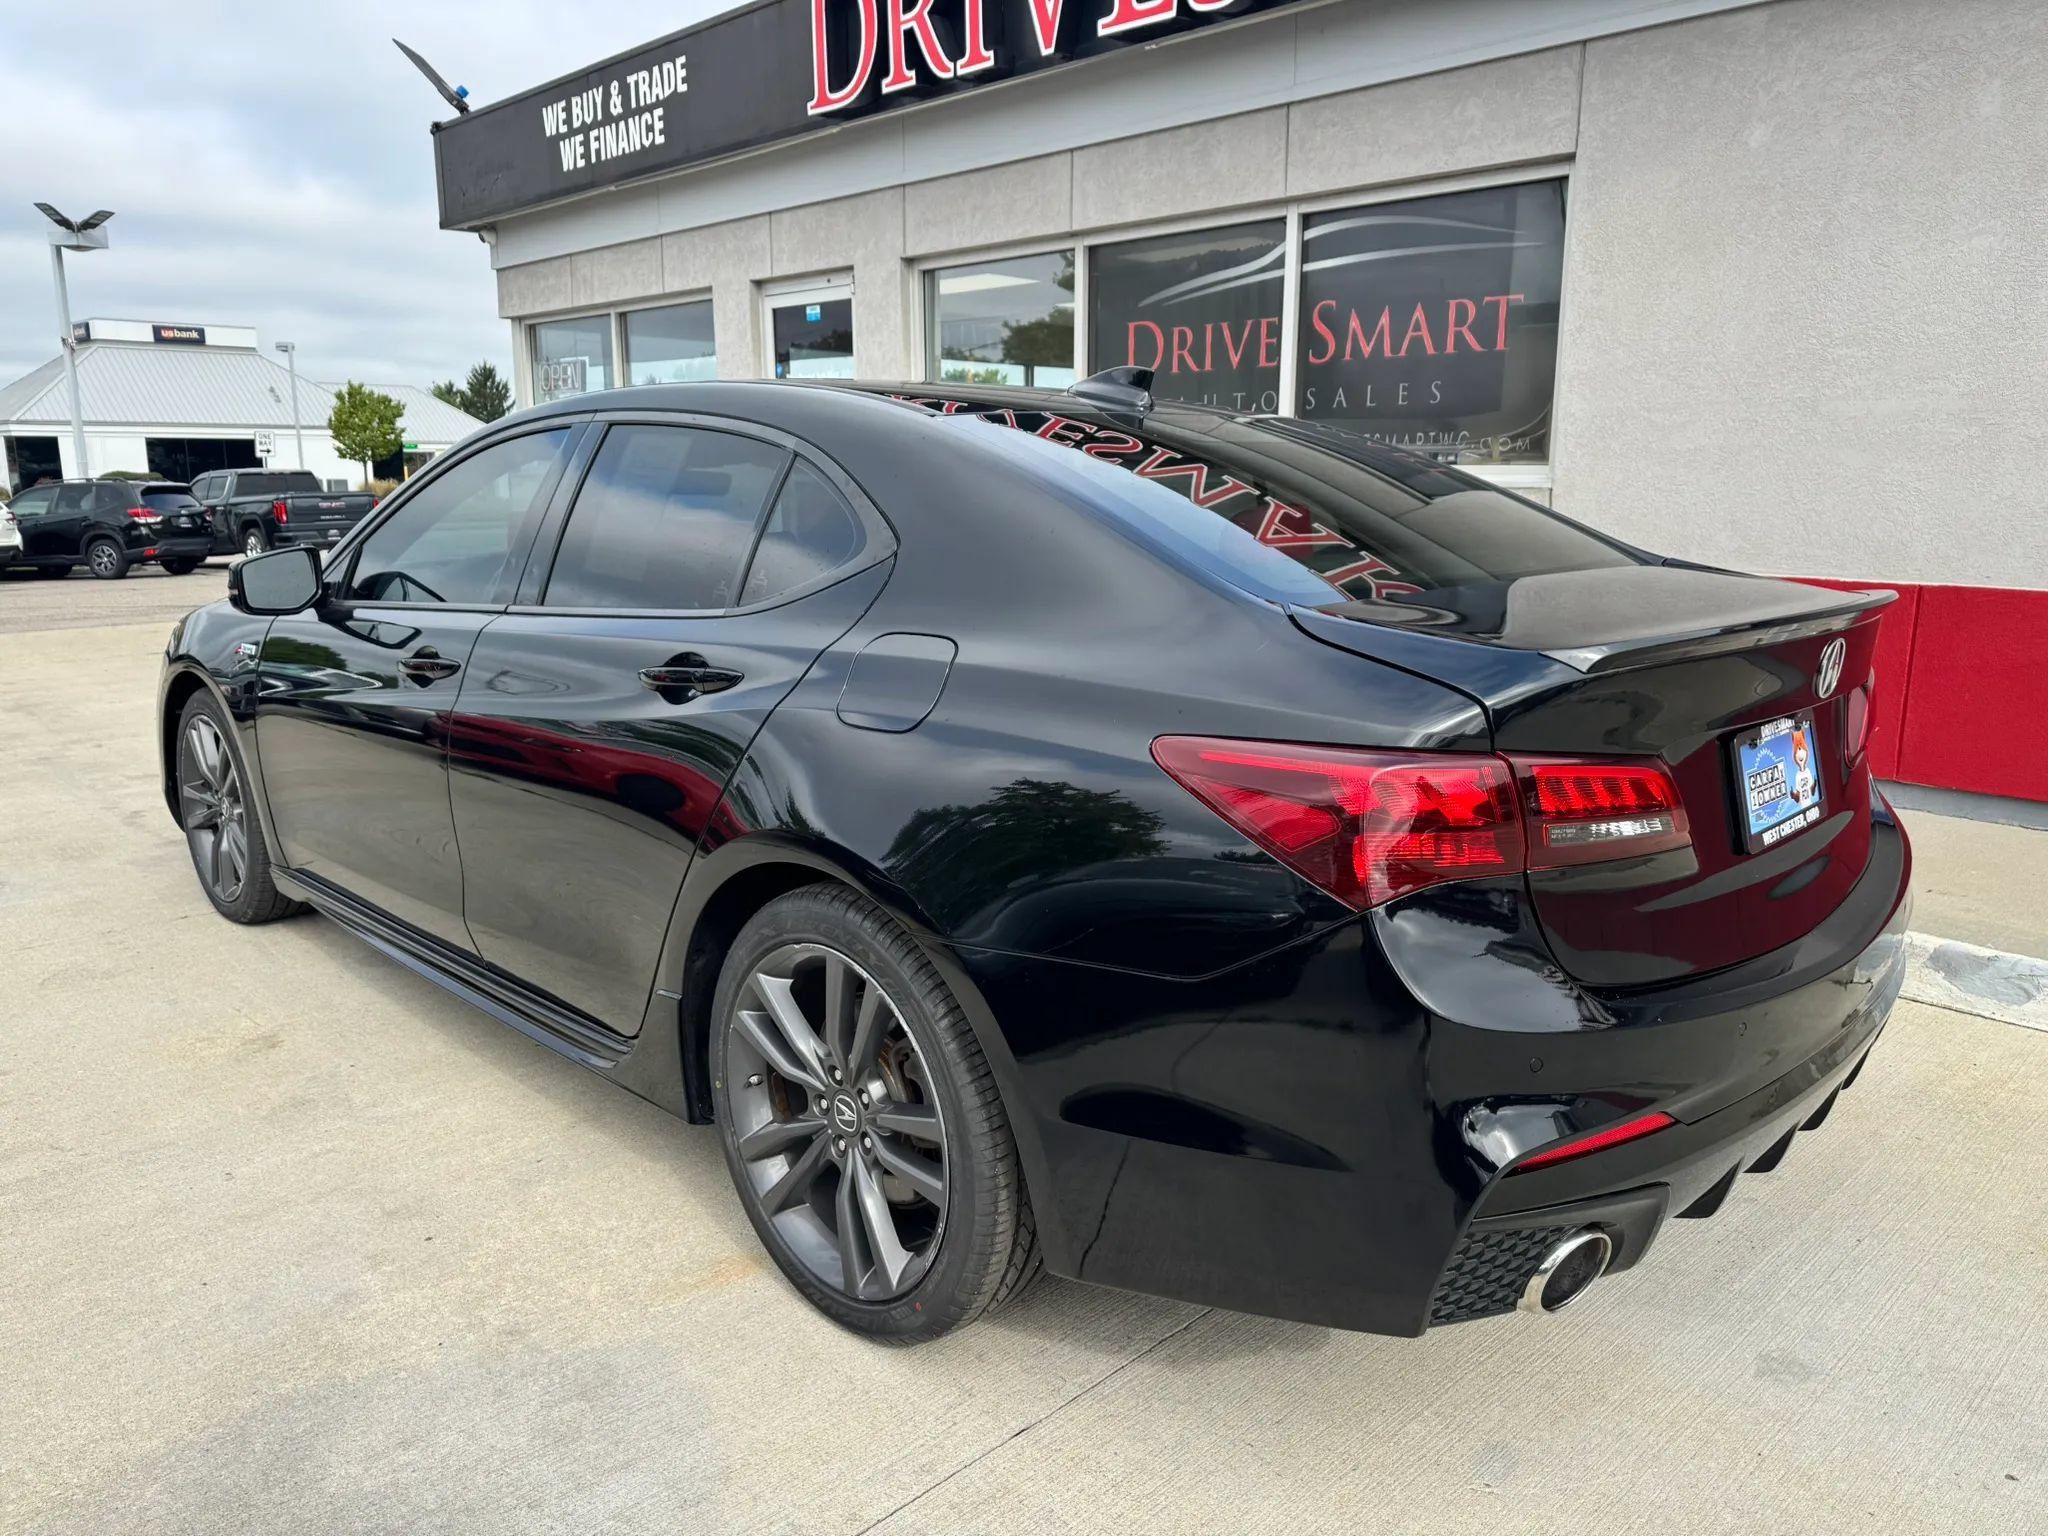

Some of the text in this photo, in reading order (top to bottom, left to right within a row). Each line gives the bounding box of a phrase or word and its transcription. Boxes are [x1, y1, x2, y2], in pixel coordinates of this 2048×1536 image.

[542, 55, 688, 137] WE BUY & TRADE
[559, 107, 665, 172] WE FINANCE
[1126, 294, 1525, 374] DRIVE SMART
[541, 362, 580, 391] OPEN
[1305, 380, 1442, 410] SALES
[1761, 826, 1780, 846] WEST
